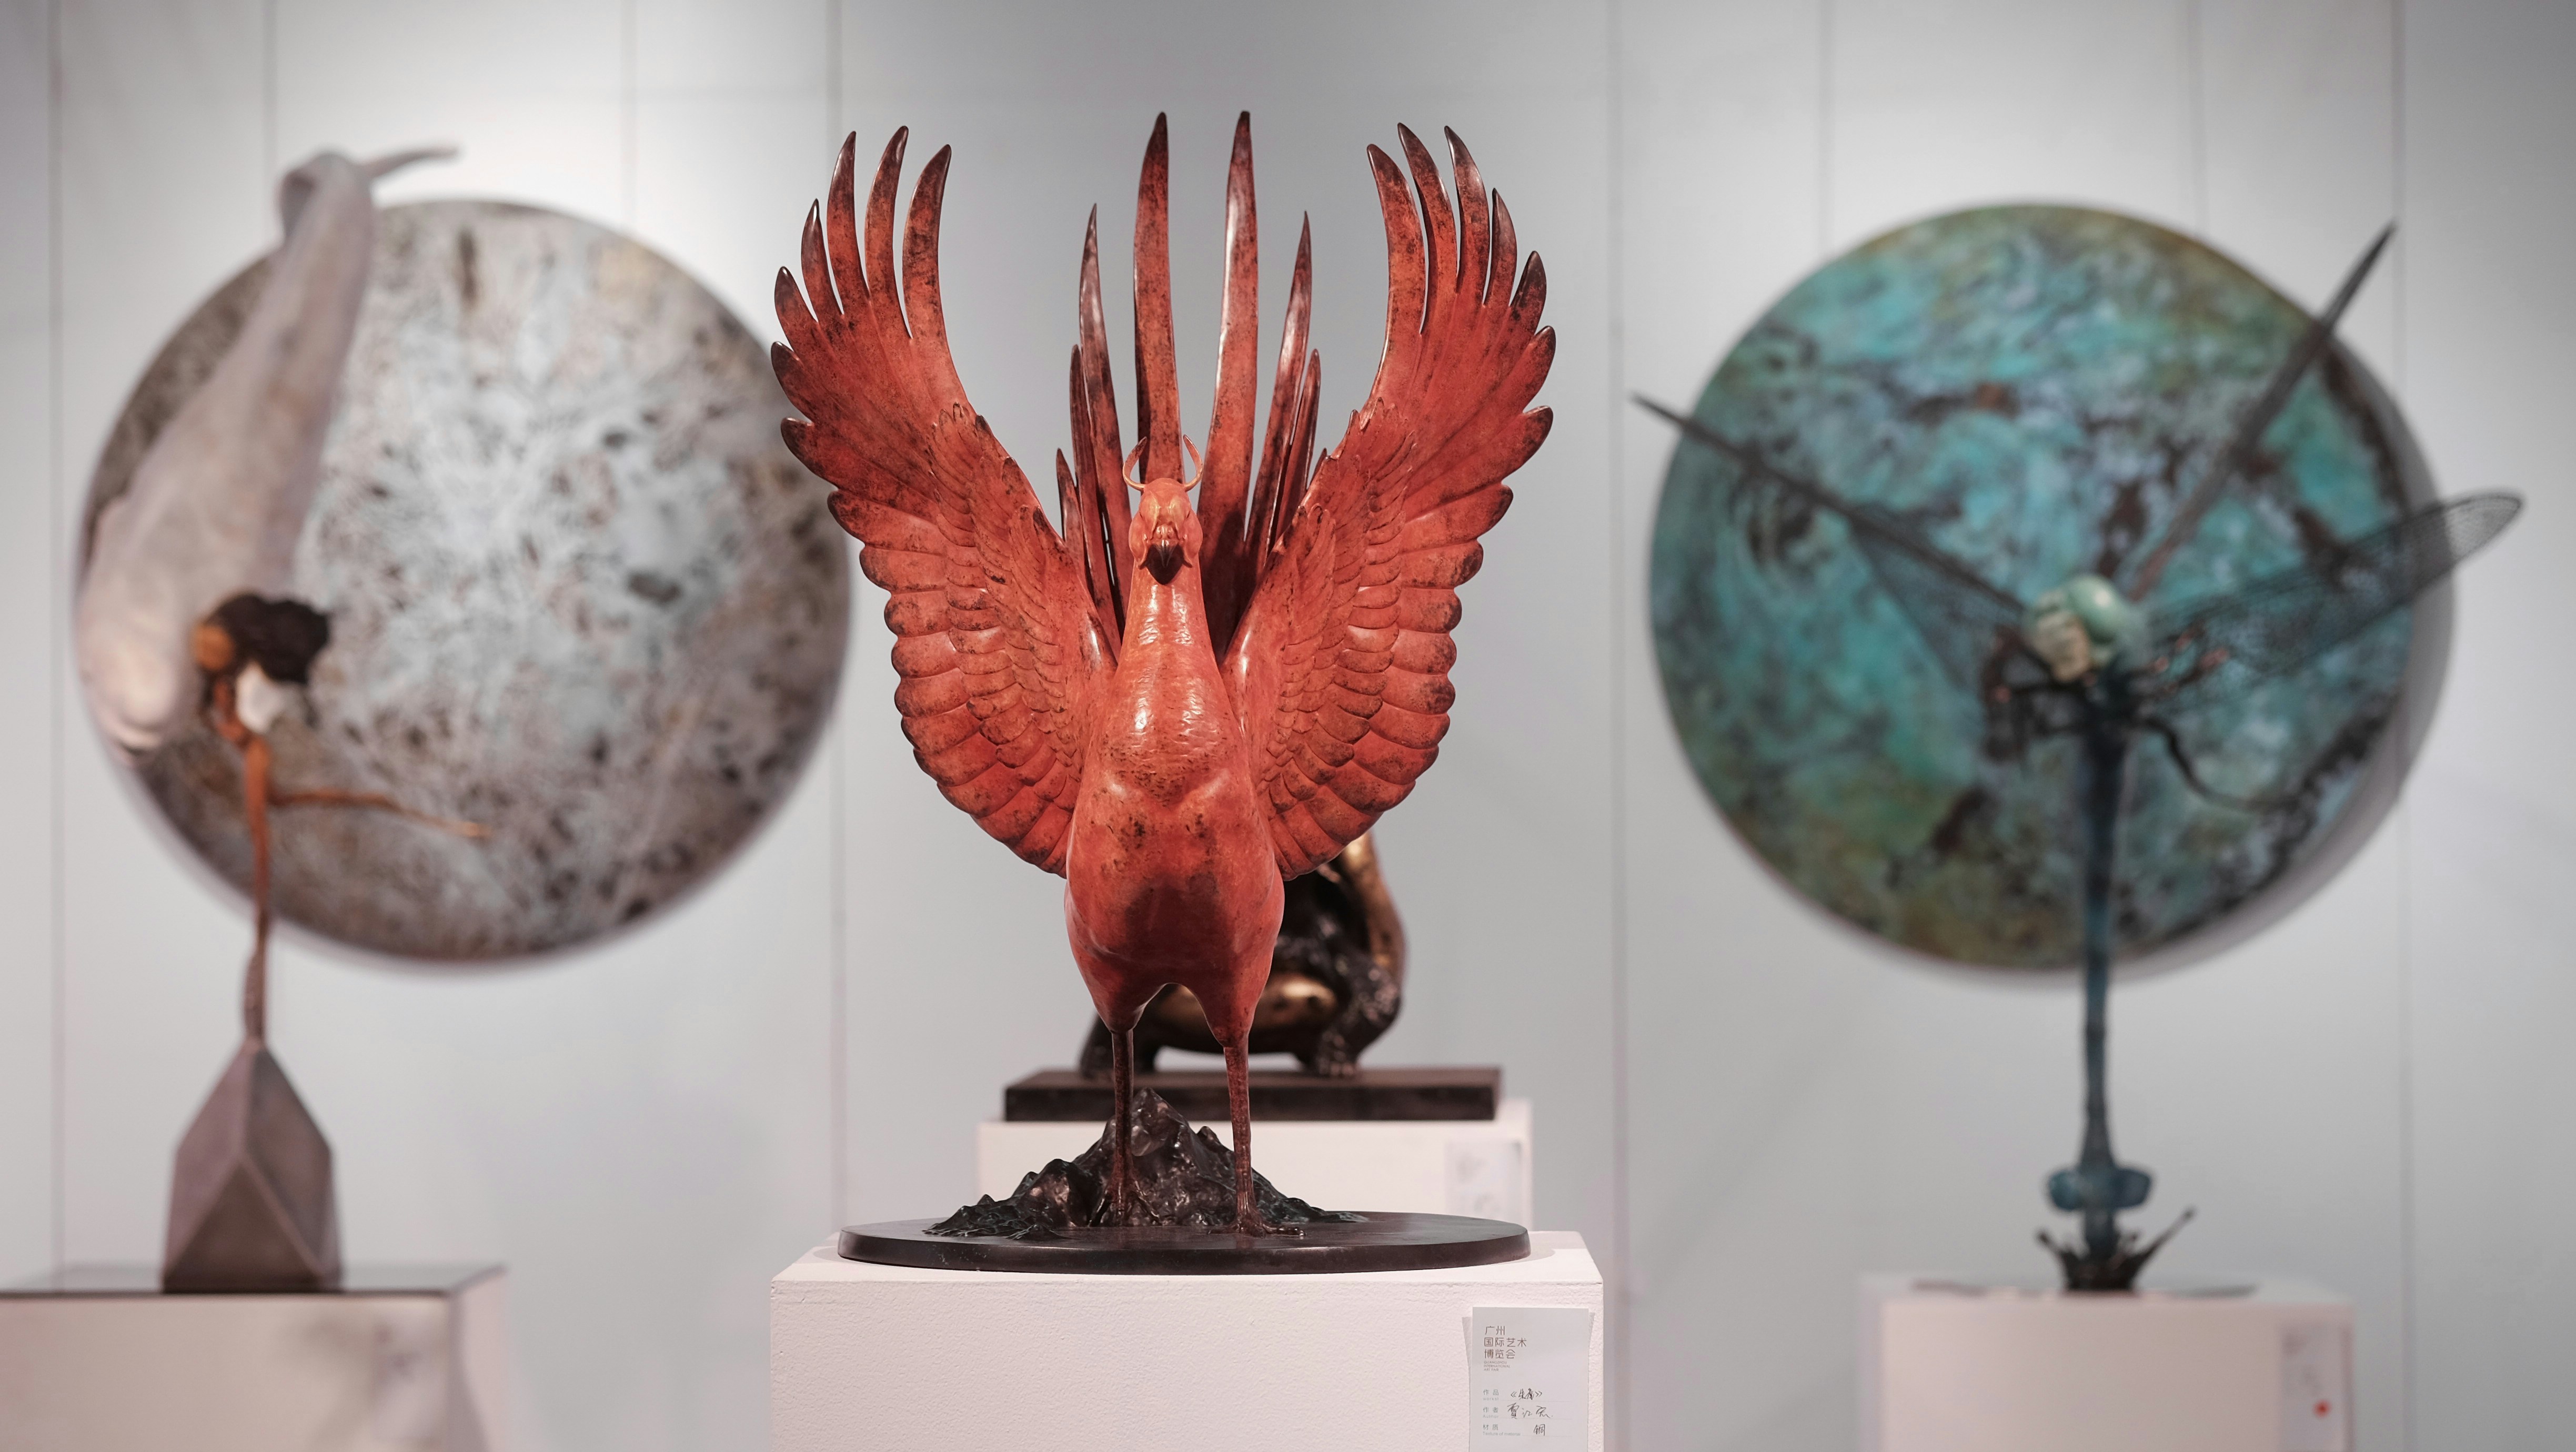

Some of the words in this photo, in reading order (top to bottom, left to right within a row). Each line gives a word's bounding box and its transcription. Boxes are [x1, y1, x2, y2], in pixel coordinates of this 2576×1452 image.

[1485, 1326, 1505, 1335] 广州
[1484, 1337, 1527, 1347] 国际艺术
[1484, 1349, 1515, 1359] 博览会
